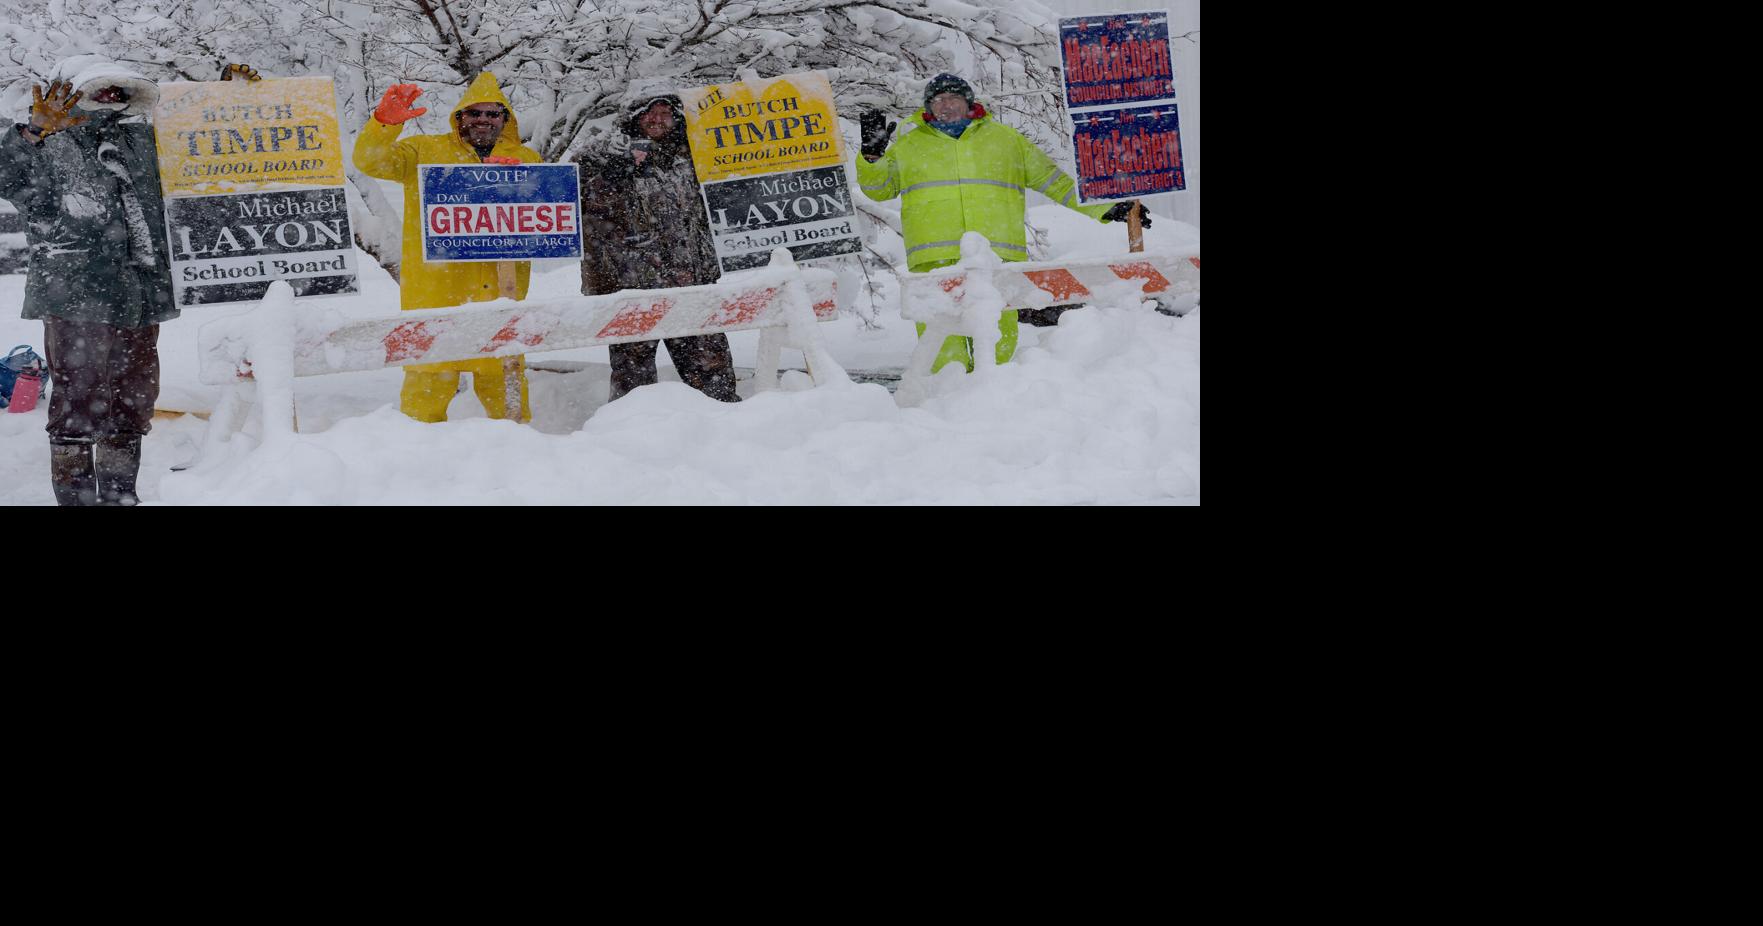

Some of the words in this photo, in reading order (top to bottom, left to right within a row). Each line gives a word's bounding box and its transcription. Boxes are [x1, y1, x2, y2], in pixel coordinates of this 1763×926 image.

[1064, 35, 1170, 83] MacEachern
[202, 102, 293, 122] BUTCH
[722, 96, 799, 119] BUTCH
[176, 124, 323, 157] TIMPE
[705, 112, 827, 149] TIMPE
[713, 148, 774, 166] SCHOOL
[778, 141, 830, 157] BOARD
[1076, 127, 1181, 178] MacEachern
[182, 161, 258, 177] SCHOOL
[263, 158, 324, 173] BOARD
[472, 170, 528, 183] VOTE!
[436, 193, 471, 203] DAVE
[760, 171, 842, 198] Michael
[1081, 176, 1133, 199] COUNCILOR
[1134, 171, 1175, 191] DISTRICT
[237, 194, 341, 219] Michael
[430, 205, 574, 234] GRANESE
[714, 192, 848, 230] LAYON
[176, 219, 345, 256] LAYON
[432, 236, 513, 249] COUNCILOR
[515, 236, 575, 247] AT-LARGE
[723, 230, 789, 251] School
[793, 221, 852, 242] Board
[183, 260, 268, 282] School
[272, 255, 347, 275] Board
